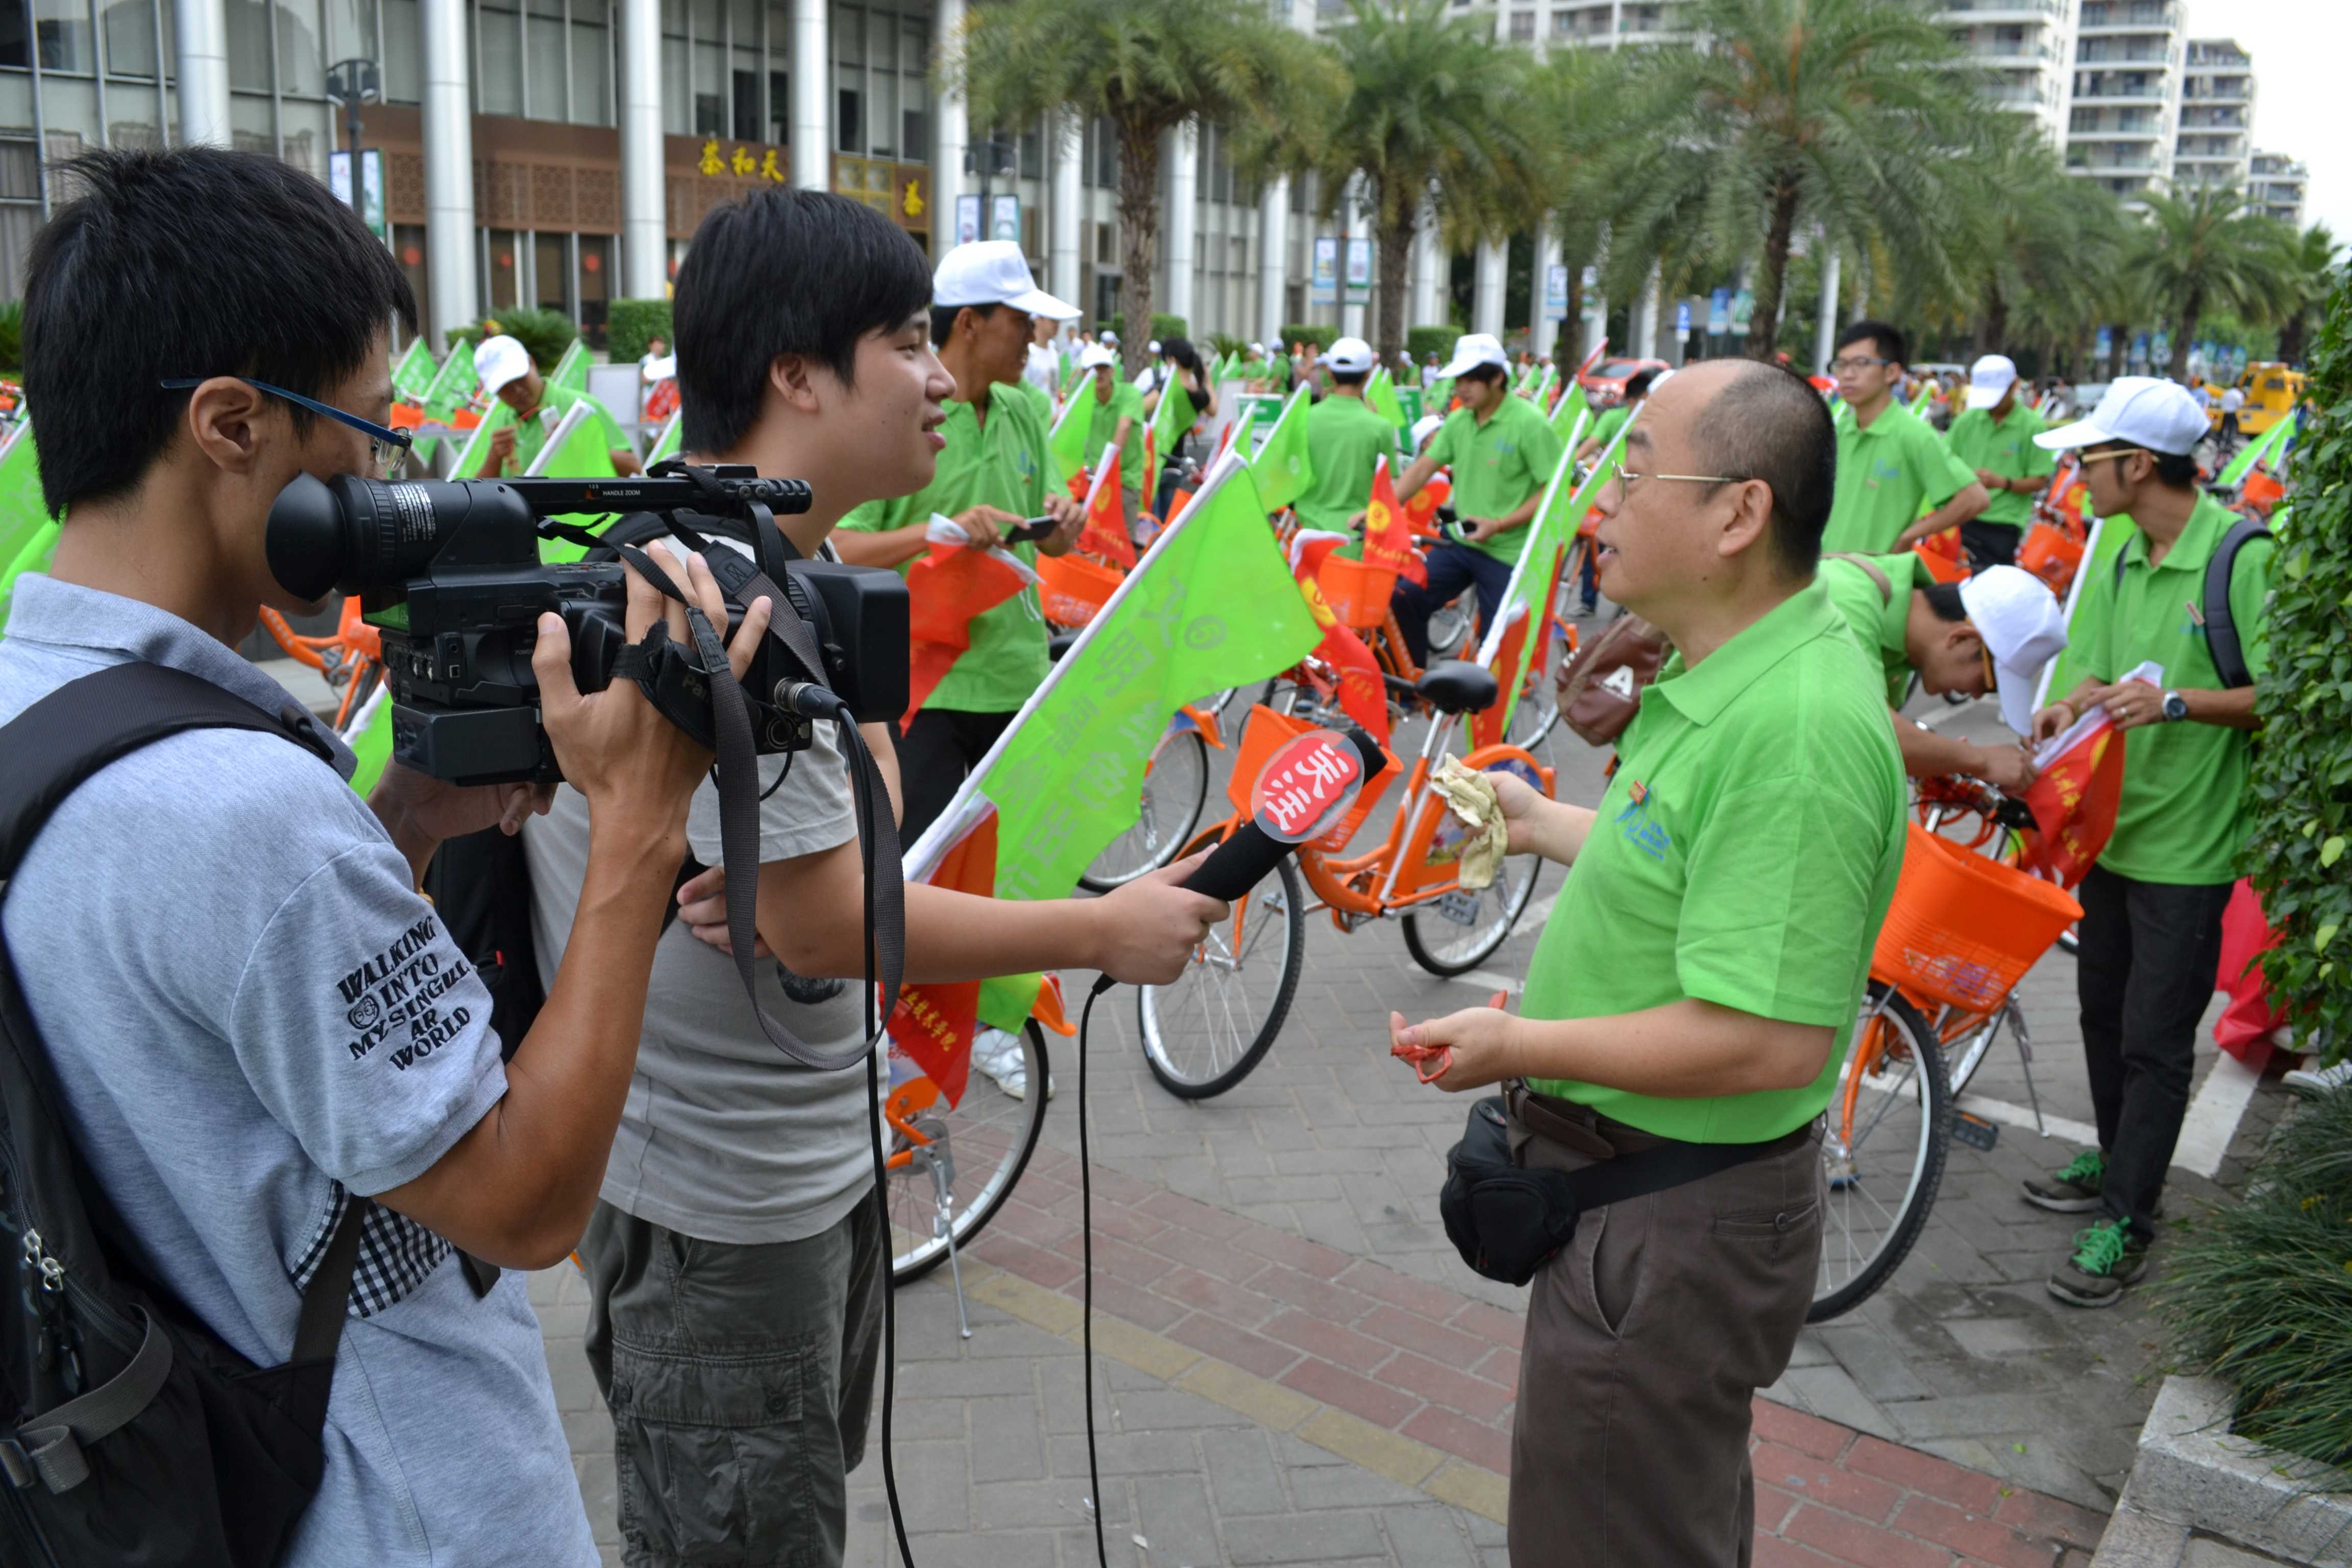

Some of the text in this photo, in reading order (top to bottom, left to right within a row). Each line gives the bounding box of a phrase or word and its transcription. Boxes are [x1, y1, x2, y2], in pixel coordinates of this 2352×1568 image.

[1263, 742, 1350, 831] 关注
[337, 915, 436, 1004] WALKING
[379, 953, 439, 1009] INTO
[348, 1020, 389, 1061] MY
[389, 1007, 471, 1071] WORLD
[410, 1008, 437, 1041] AR
